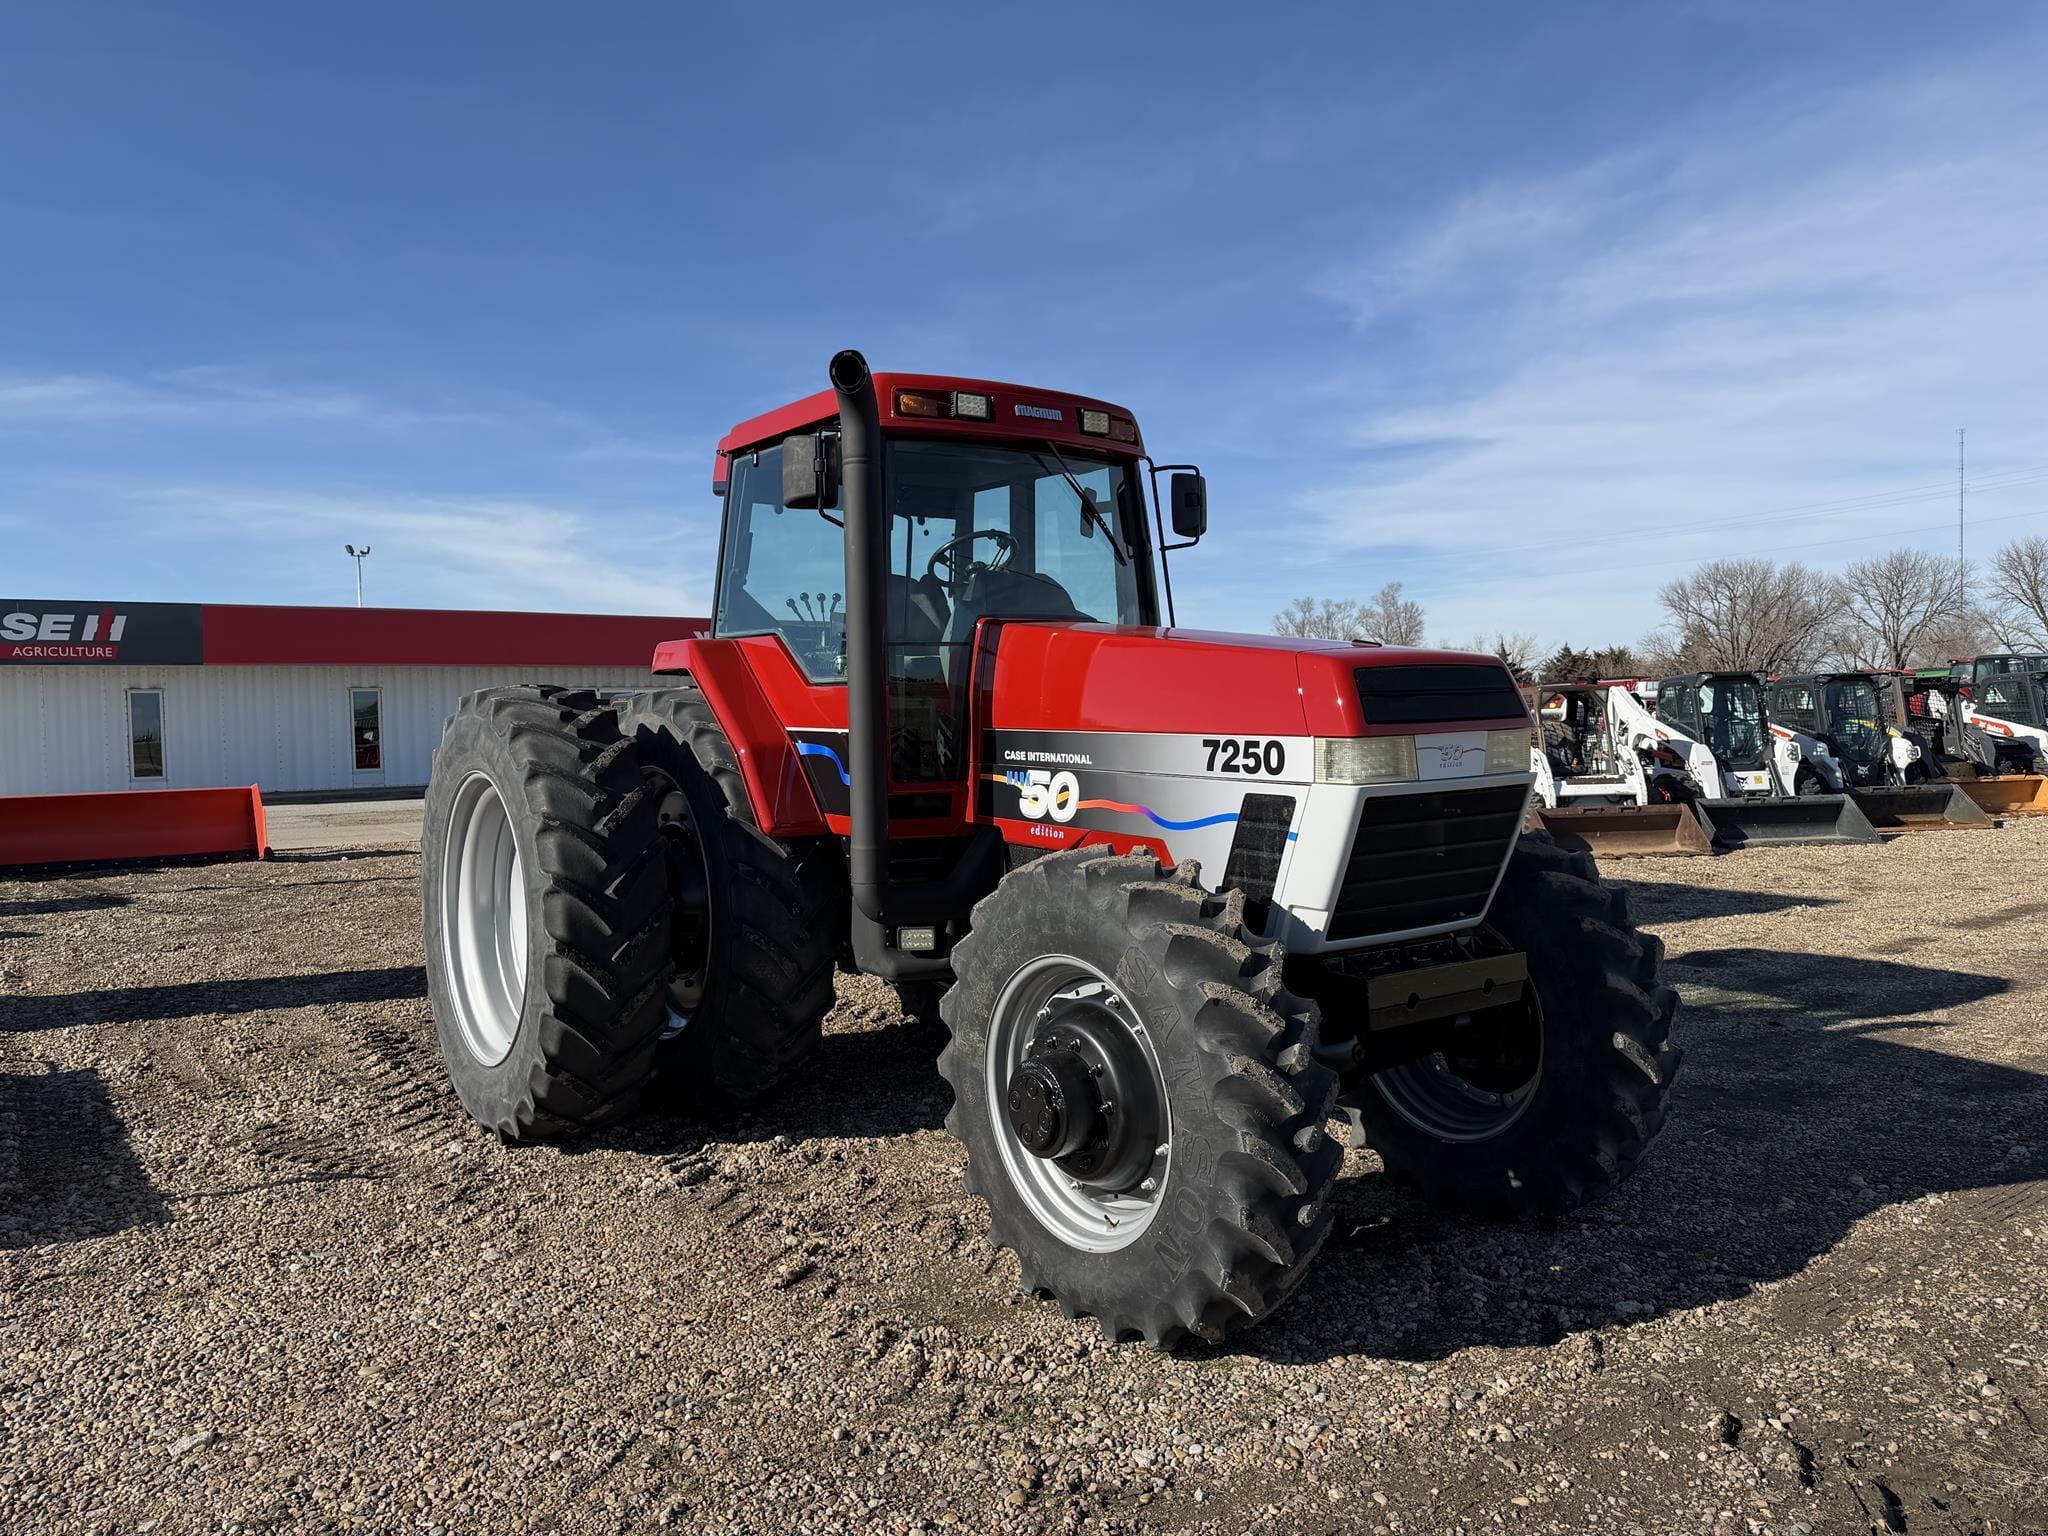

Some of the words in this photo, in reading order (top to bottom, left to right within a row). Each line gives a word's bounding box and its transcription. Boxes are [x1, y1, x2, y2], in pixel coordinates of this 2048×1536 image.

[12, 646, 113, 657] AGRICULTURE
[1004, 750, 1026, 761] CASE
[1027, 751, 1092, 764] INTERNATIONAL
[1202, 739, 1285, 776] 7250
[1019, 769, 1080, 823] 50
[1030, 825, 1065, 839] edition
[1117, 946, 1214, 1283] SAMSON
